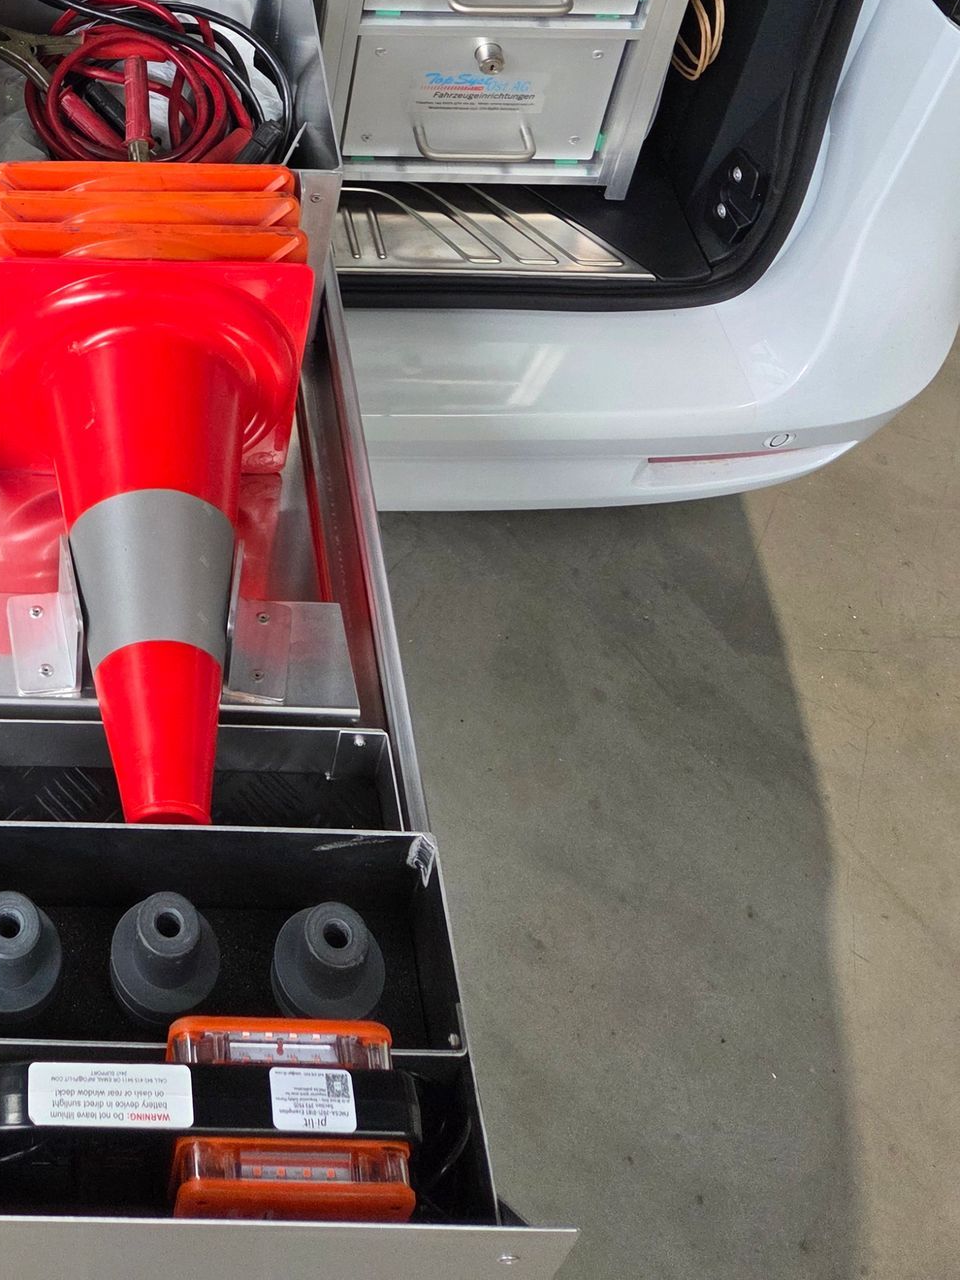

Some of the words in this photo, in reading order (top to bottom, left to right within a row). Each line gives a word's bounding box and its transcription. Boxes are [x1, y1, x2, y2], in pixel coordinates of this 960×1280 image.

[513, 79, 531, 93] AG
[433, 91, 536, 101] Fahrzeugeinrichtungen
[55, 1089, 75, 1098] deck!
[77, 1089, 105, 1098] window
[134, 1090, 152, 1099] dash
[52, 1099, 81, 1109] sunlight
[83, 1101, 104, 1109] direct
[106, 1101, 113, 1109] in
[115, 1101, 140, 1110] device
[142, 1100, 168, 1110] battery
[50, 1111, 75, 1121] lithium
[76, 1111, 97, 1121] leave
[99, 1111, 111, 1121] not
[113, 1111, 124, 1121] Do
[126, 1111, 171, 1122] WARNING:
